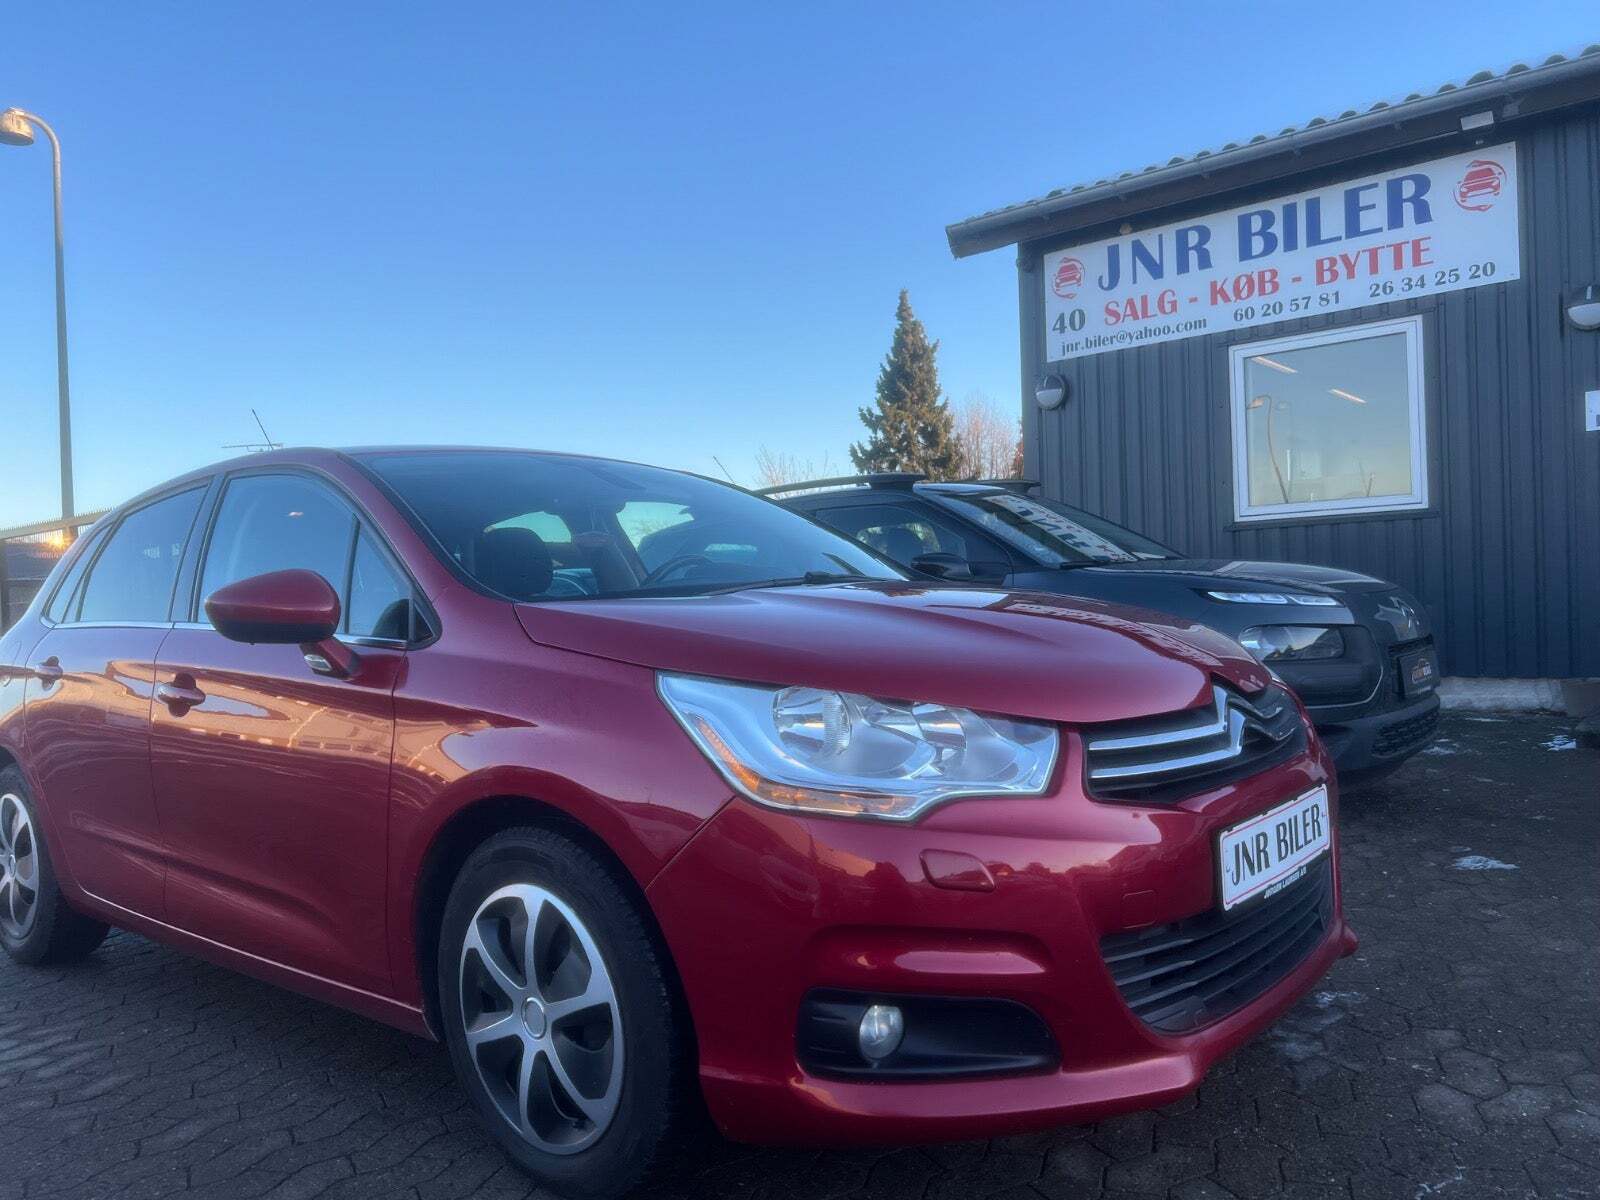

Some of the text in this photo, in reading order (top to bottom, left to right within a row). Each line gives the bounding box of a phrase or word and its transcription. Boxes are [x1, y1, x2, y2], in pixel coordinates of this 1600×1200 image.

[1098, 173, 1433, 292] JNR BILER
[1104, 288, 1178, 326] SALG
[1209, 267, 1280, 306] KØB
[1315, 236, 1434, 286] BYTTE
[1369, 261, 1496, 298] 26 34 25 20
[1052, 308, 1086, 334] 40
[1233, 290, 1340, 322] 60 20 57 81
[1061, 317, 1207, 357] jnr.biler@yahoo.com
[1231, 831, 1271, 887] JNR
[1275, 803, 1322, 864] BILER
